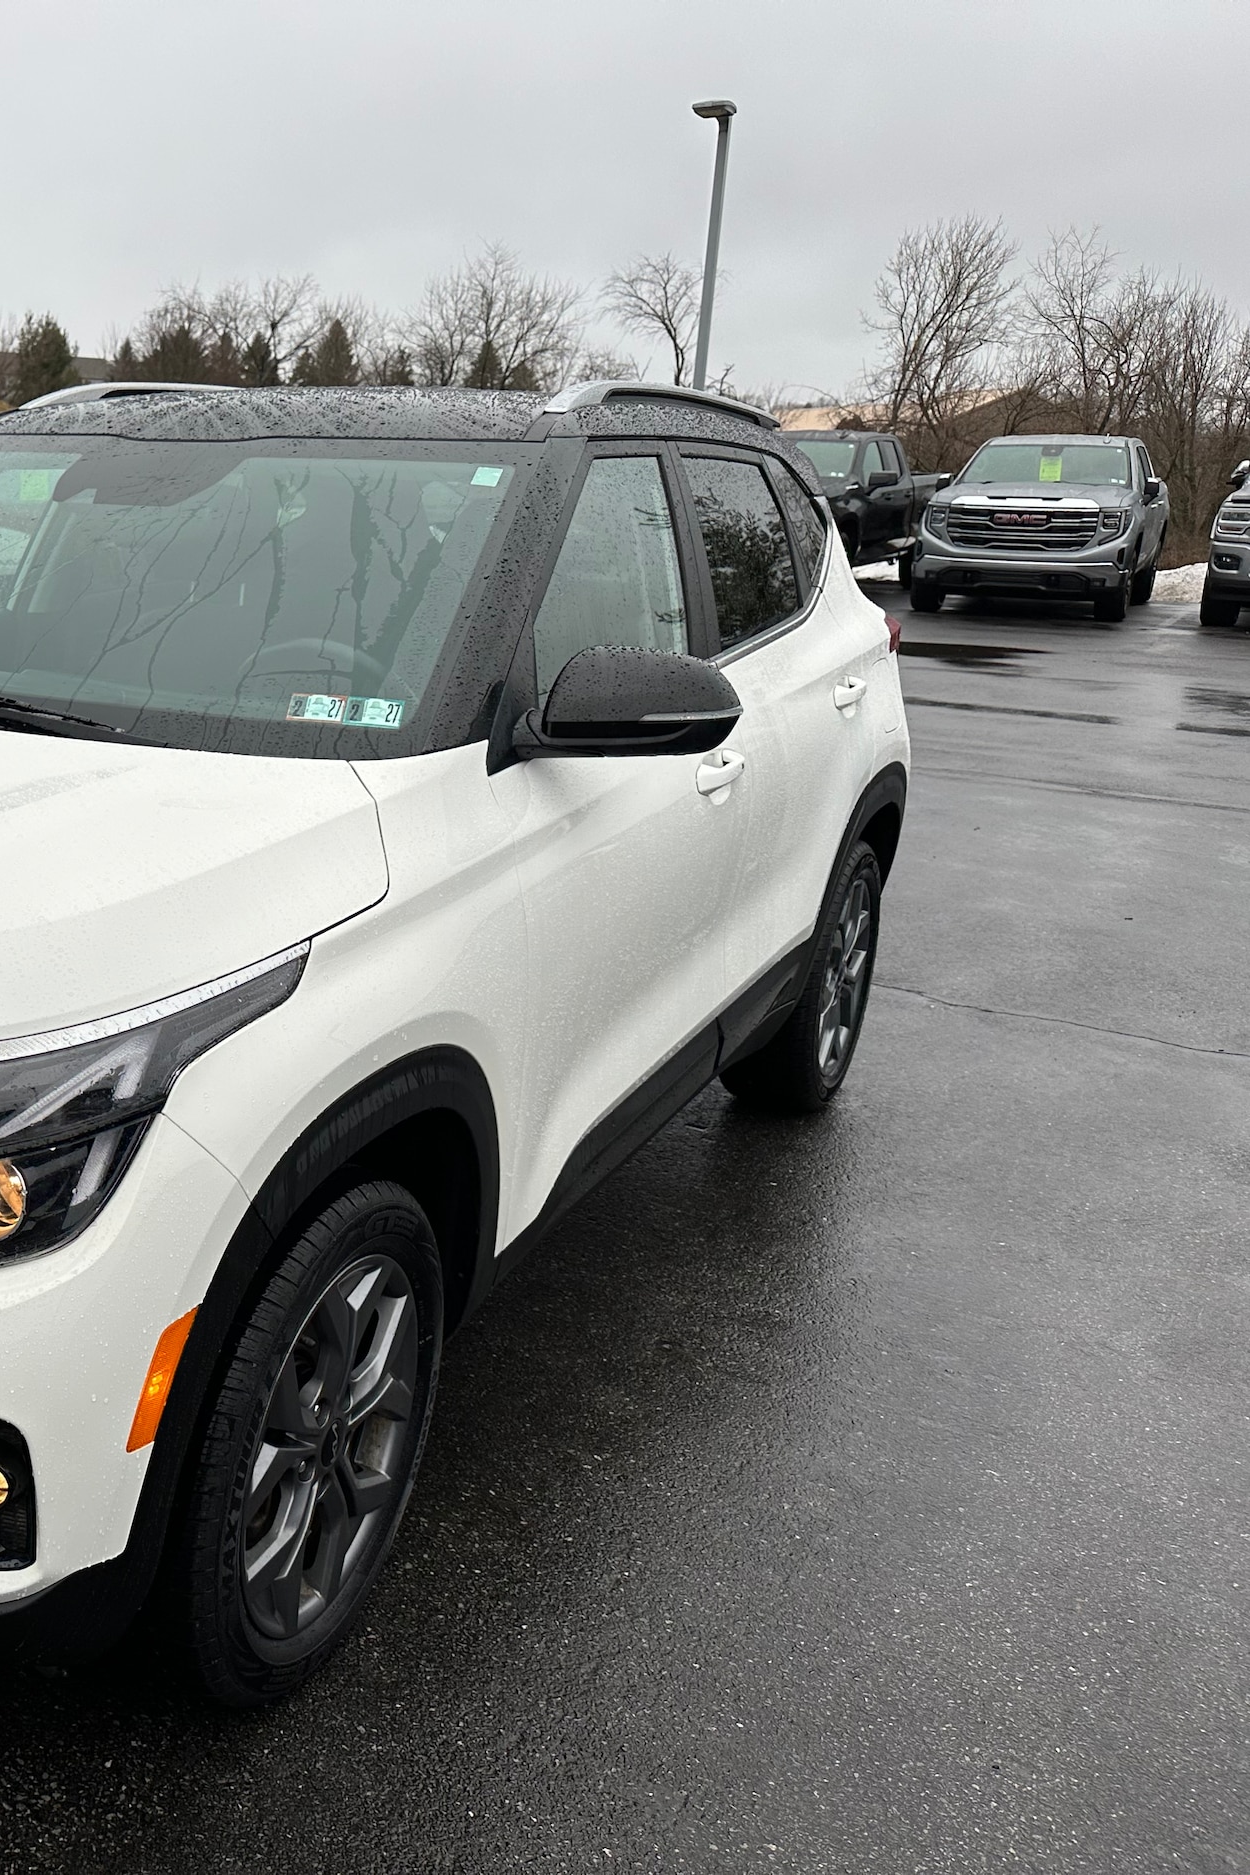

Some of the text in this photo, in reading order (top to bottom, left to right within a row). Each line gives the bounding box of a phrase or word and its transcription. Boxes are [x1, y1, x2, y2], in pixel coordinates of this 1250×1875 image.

[993, 513, 1048, 525] GMC
[291, 700, 303, 717] 2
[327, 699, 343, 719] 27
[349, 703, 360, 721] 2
[384, 702, 401, 724] 27
